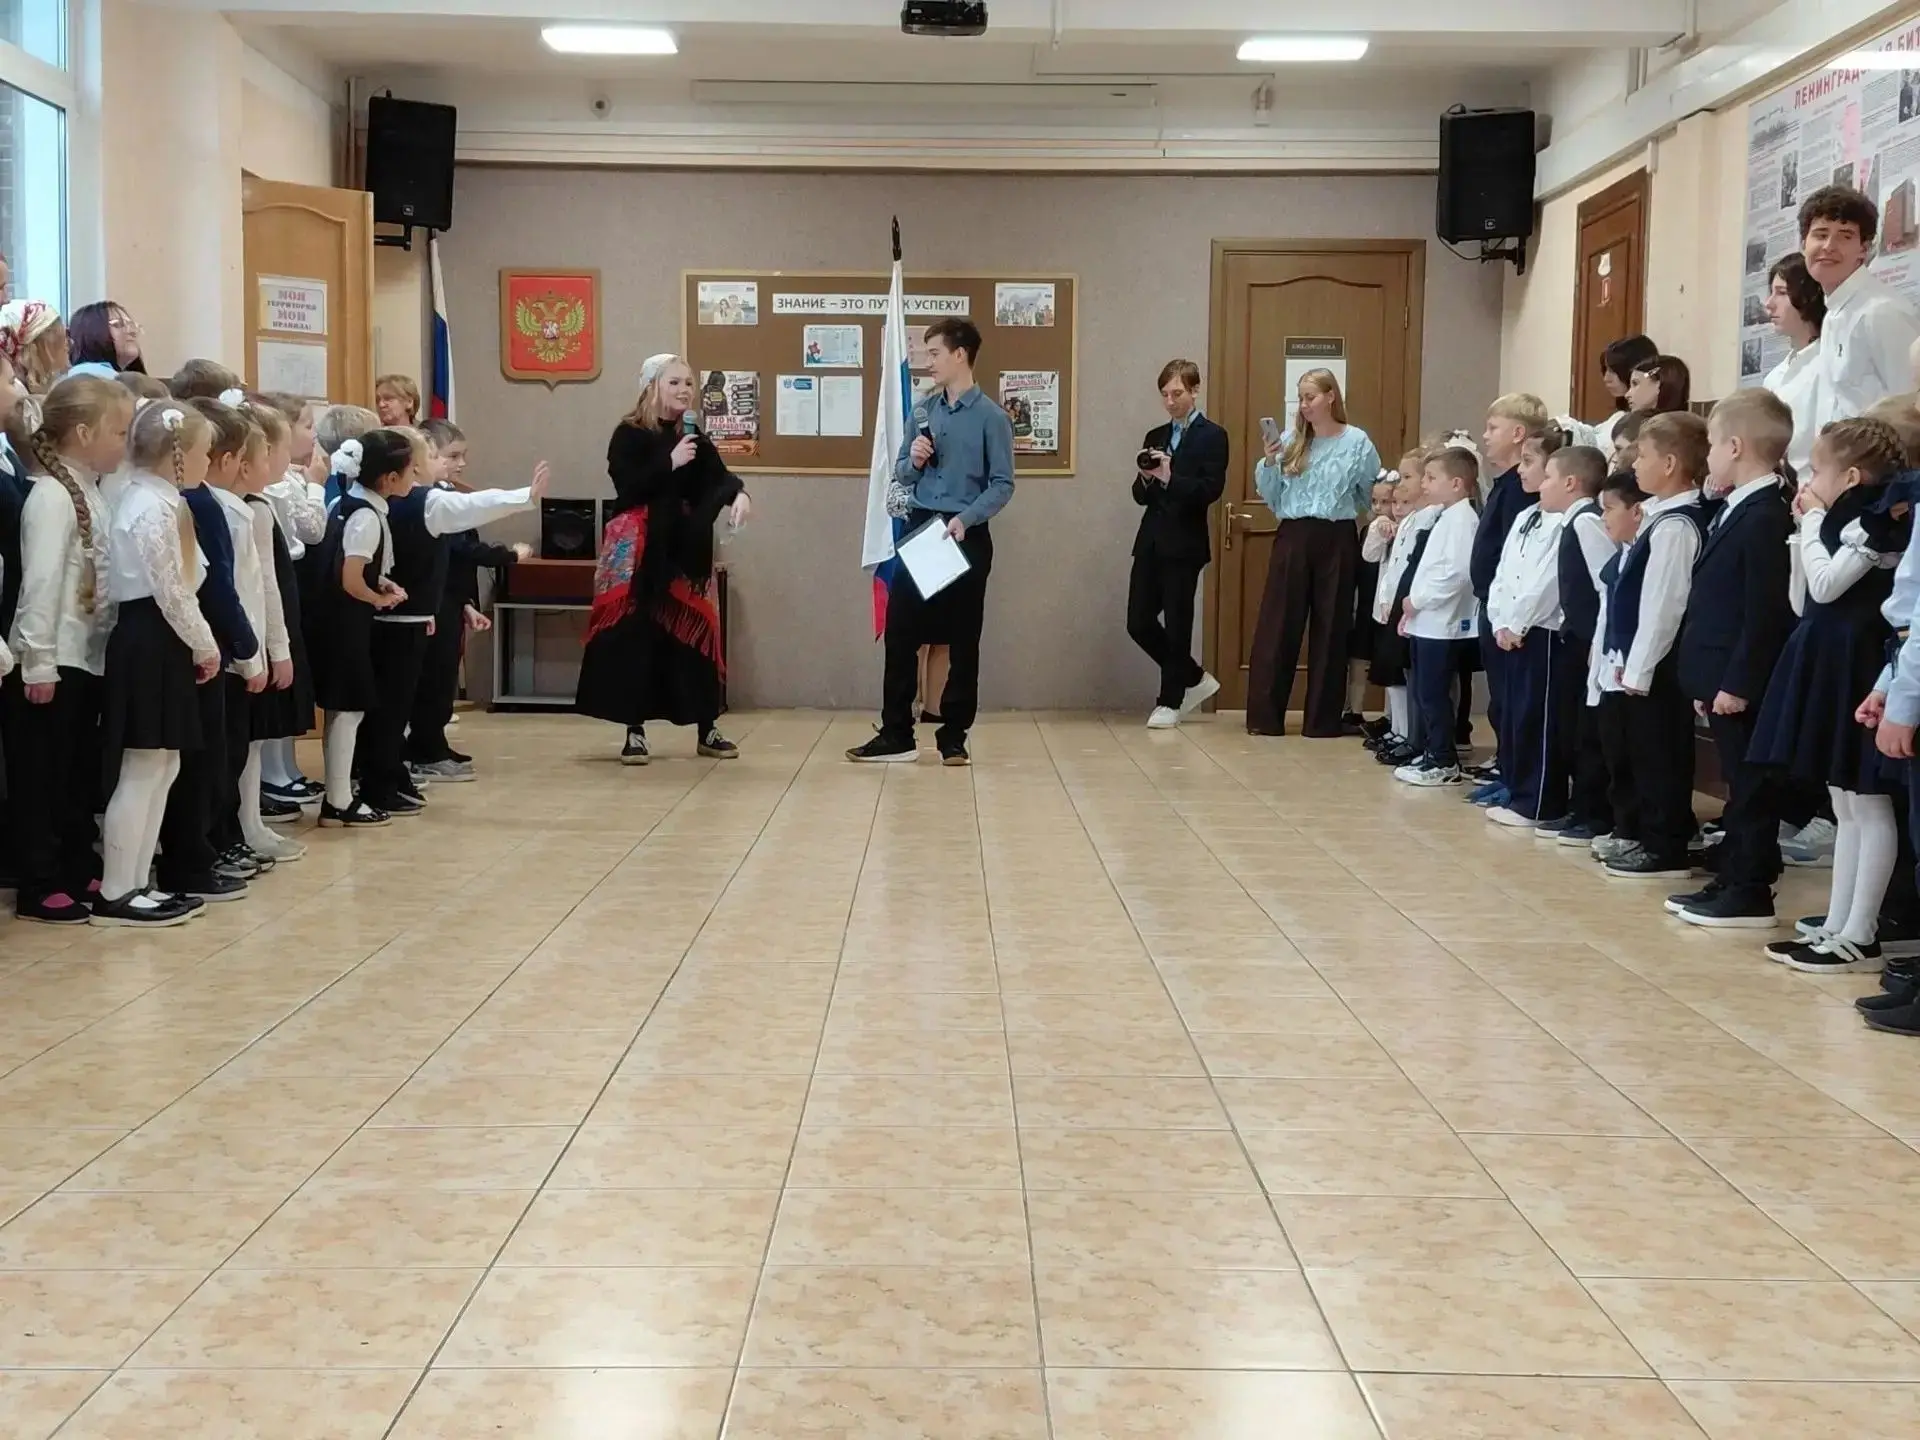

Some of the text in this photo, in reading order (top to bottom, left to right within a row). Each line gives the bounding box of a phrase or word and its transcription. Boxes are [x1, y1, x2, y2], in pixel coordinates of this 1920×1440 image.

[777, 298, 826, 309] ЗНАНИЕ
[840, 298, 864, 309] ЭТО
[868, 298, 889, 310] ПУТ
[914, 299, 965, 311] УСПЕХУ!
